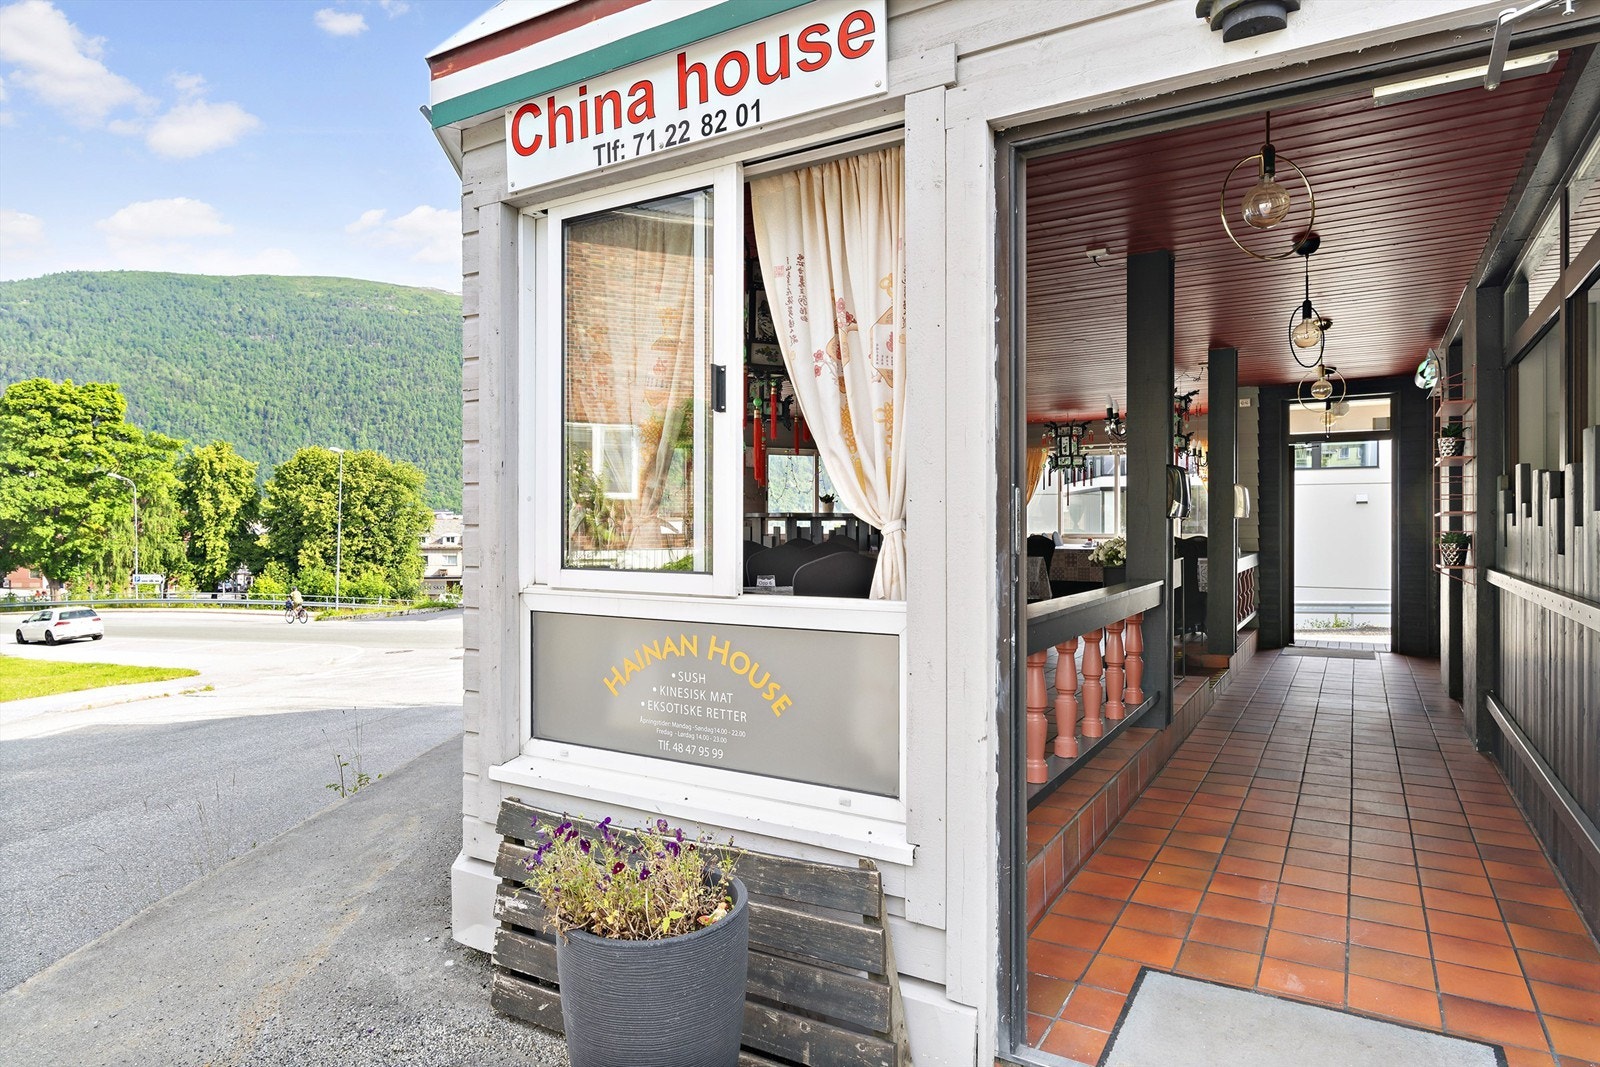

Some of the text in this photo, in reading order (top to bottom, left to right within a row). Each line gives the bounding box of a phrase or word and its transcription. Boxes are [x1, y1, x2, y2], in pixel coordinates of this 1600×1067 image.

[511, 9, 876, 157] China house
[593, 98, 760, 166] Tlf: 71 22 82 01
[603, 633, 793, 718] HAINAN HOUSE
[677, 671, 706, 684] SUSH
[659, 685, 734, 704] KINESISK MAT
[647, 700, 747, 723] EKSOTISKE RETTER
[658, 739, 724, 759] Tlf. 48 47 95 99
